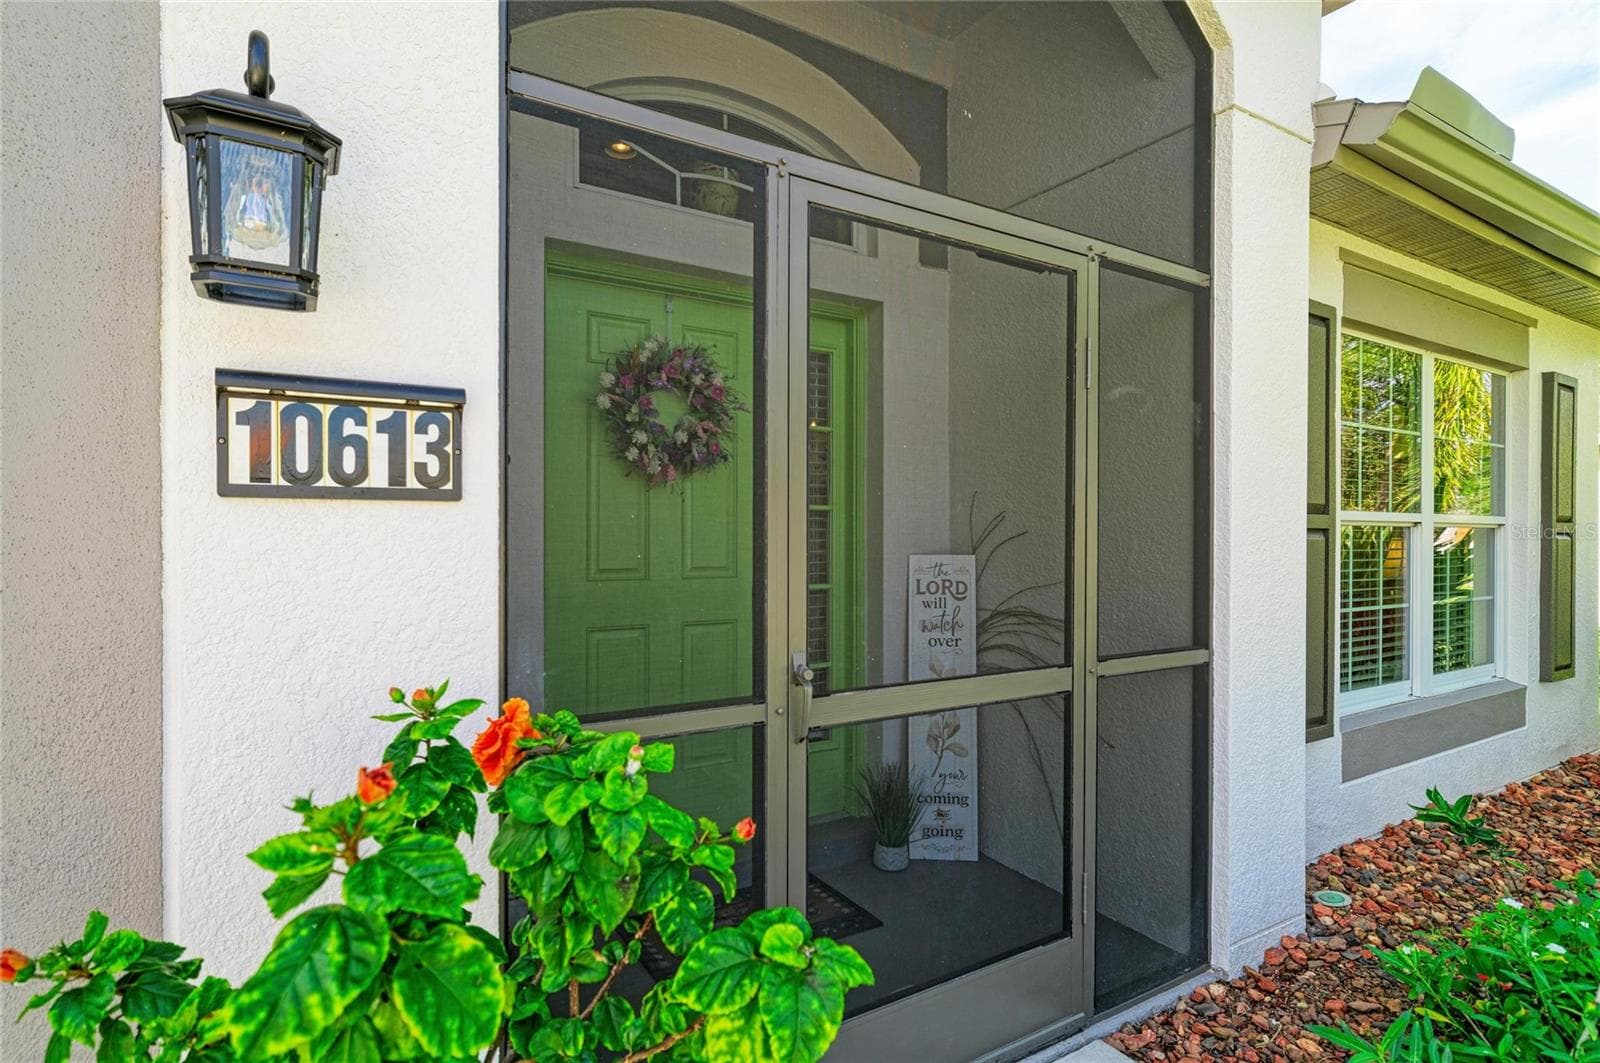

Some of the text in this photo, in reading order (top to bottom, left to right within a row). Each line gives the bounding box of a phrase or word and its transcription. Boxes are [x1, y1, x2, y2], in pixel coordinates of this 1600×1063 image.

[235, 400, 452, 489] 10613
[925, 562, 952, 578] the
[915, 578, 968, 601] LORD
[922, 597, 947, 609] will
[921, 605, 964, 637] watch
[928, 637, 962, 647] over
[917, 793, 969, 808] coming
[922, 825, 963, 840] going
